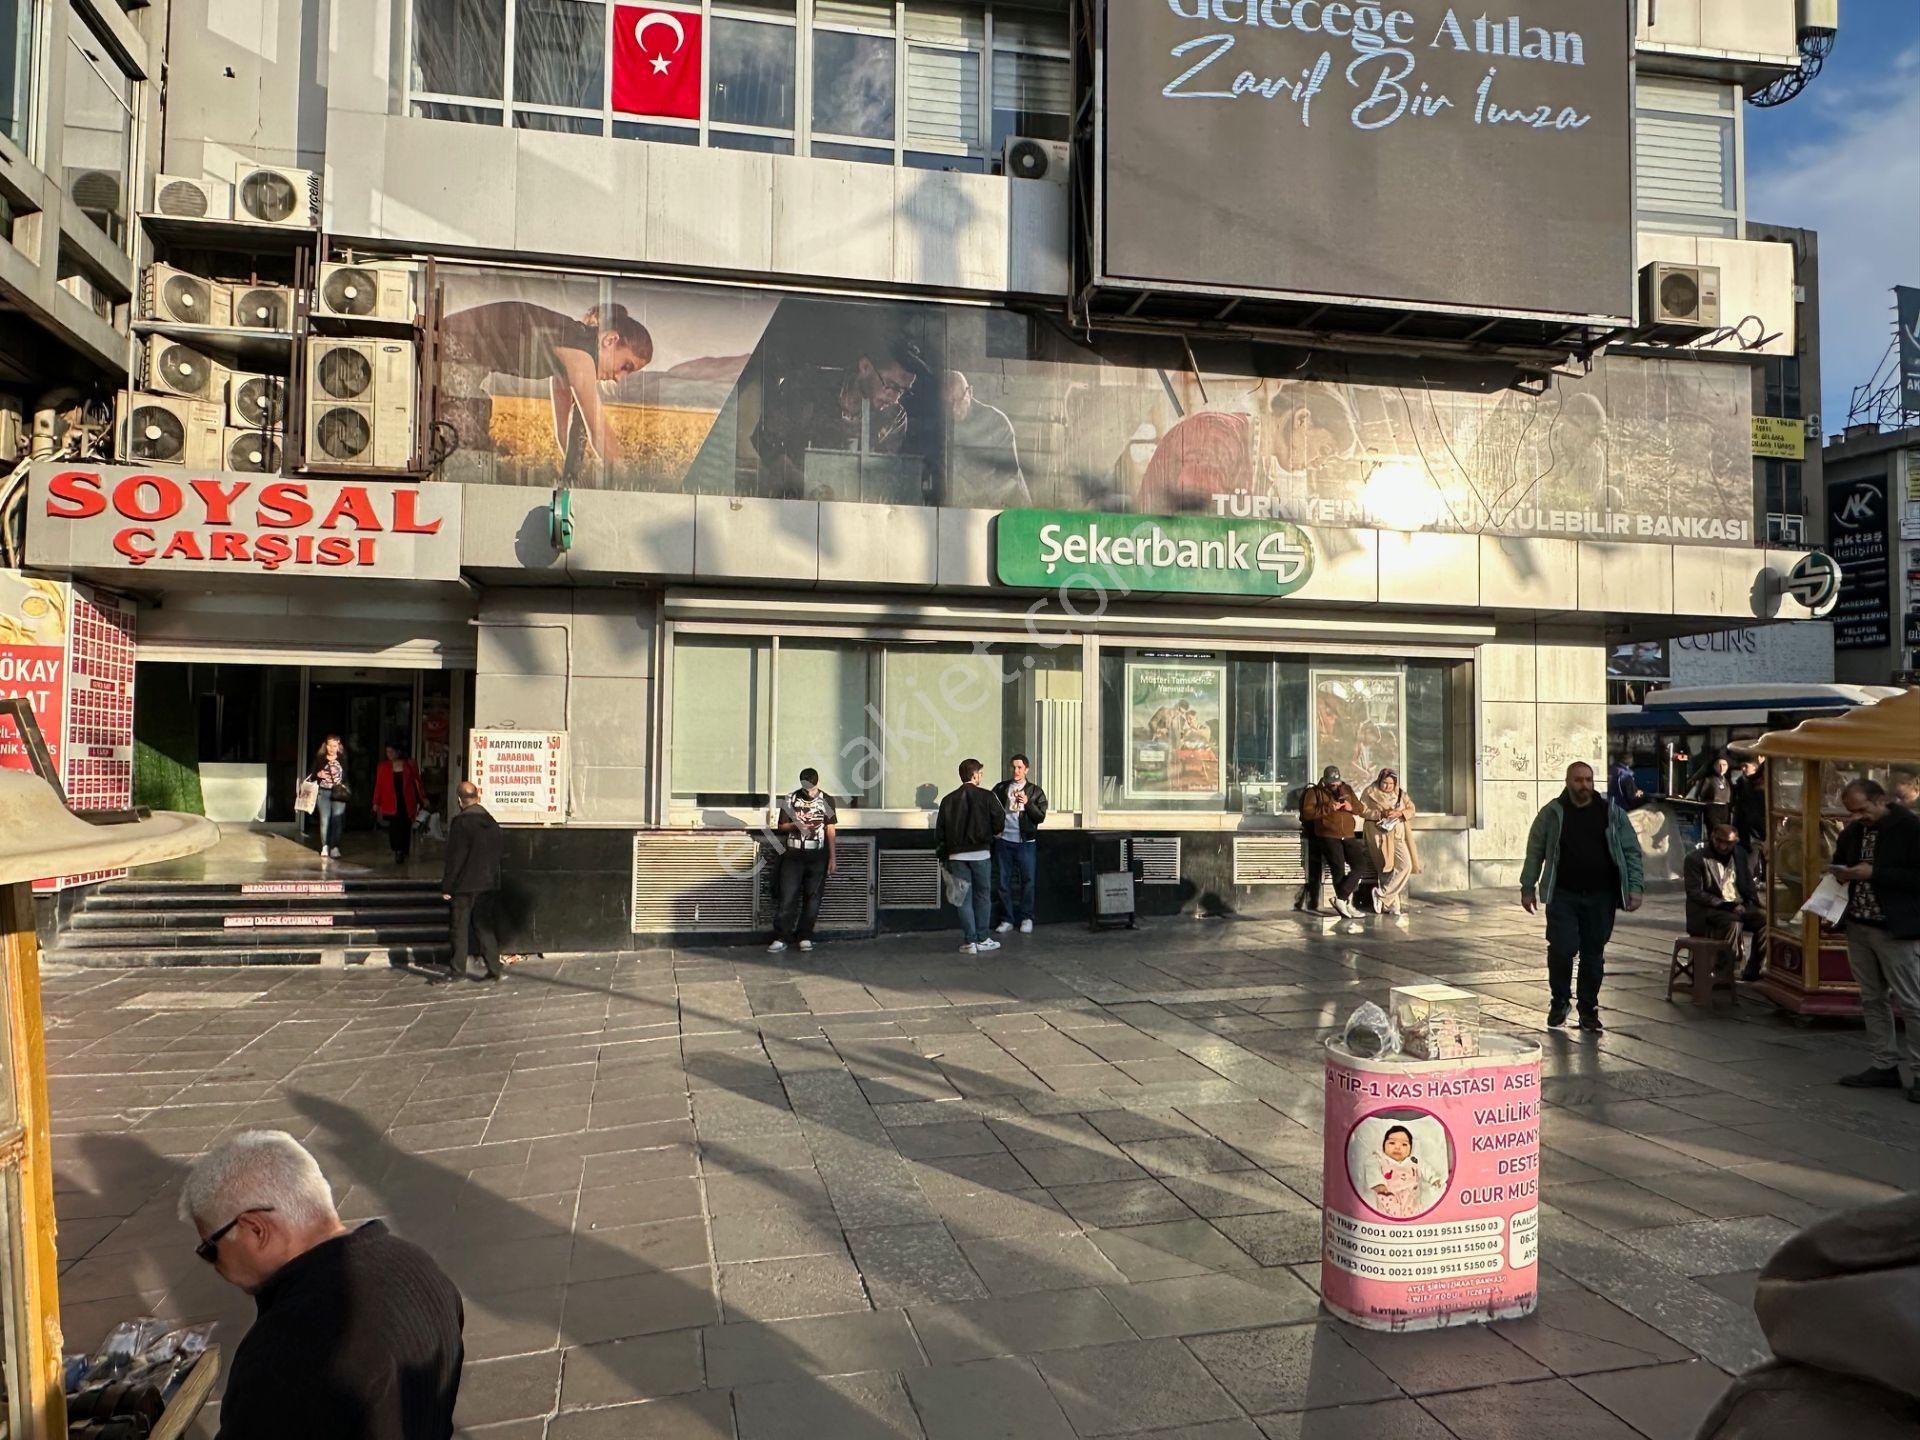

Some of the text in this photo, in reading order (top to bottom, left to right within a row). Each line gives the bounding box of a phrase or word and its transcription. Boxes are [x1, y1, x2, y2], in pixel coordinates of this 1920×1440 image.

[1429, 7, 1587, 66] Atılan
[1162, 33, 1592, 130] Zarif Bir İmza
[307, 174, 319, 215] arçelik
[46, 470, 444, 535] SOYSAL
[1635, 514, 1749, 542] BANKASI
[112, 526, 377, 569] ÇARŞISI
[1038, 521, 1251, 575] Şekerbank
[489, 740, 543, 750] KAPATIYORUZ
[496, 752, 536, 762] ZARARINA
[489, 764, 543, 775] SATIŞLARIMIZ
[1337, 1072, 1381, 1097] TİP-1
[1386, 1083, 1422, 1099] KAS
[1427, 1077, 1495, 1097] HASTASI
[1503, 1073, 1536, 1091] ASEL
[1474, 1102, 1531, 1126] VALİLİK
[1460, 1179, 1538, 1205] OLUR MUS
[1361, 1226, 1387, 1238] 0001
[1389, 1229, 1414, 1238] 0021
[1416, 1228, 1438, 1237] 0191
[1441, 1225, 1463, 1235] 9511
[1465, 1223, 1486, 1233] 5150
[1488, 1221, 1498, 1230] 03
[1360, 1245, 1386, 1257] 0001
[1389, 1248, 1414, 1257] 0021
[1416, 1247, 1438, 1257] 0191
[1440, 1244, 1462, 1254] 9511
[1464, 1242, 1486, 1252] 5150
[1487, 1240, 1498, 1249] 04
[1360, 1264, 1386, 1276] 0001
[1388, 1267, 1413, 1276] 0021
[1415, 1265, 1437, 1275] 0191
[1440, 1264, 1462, 1274] 9511
[1464, 1260, 1485, 1271] 5150
[1487, 1258, 1498, 1268] 05
